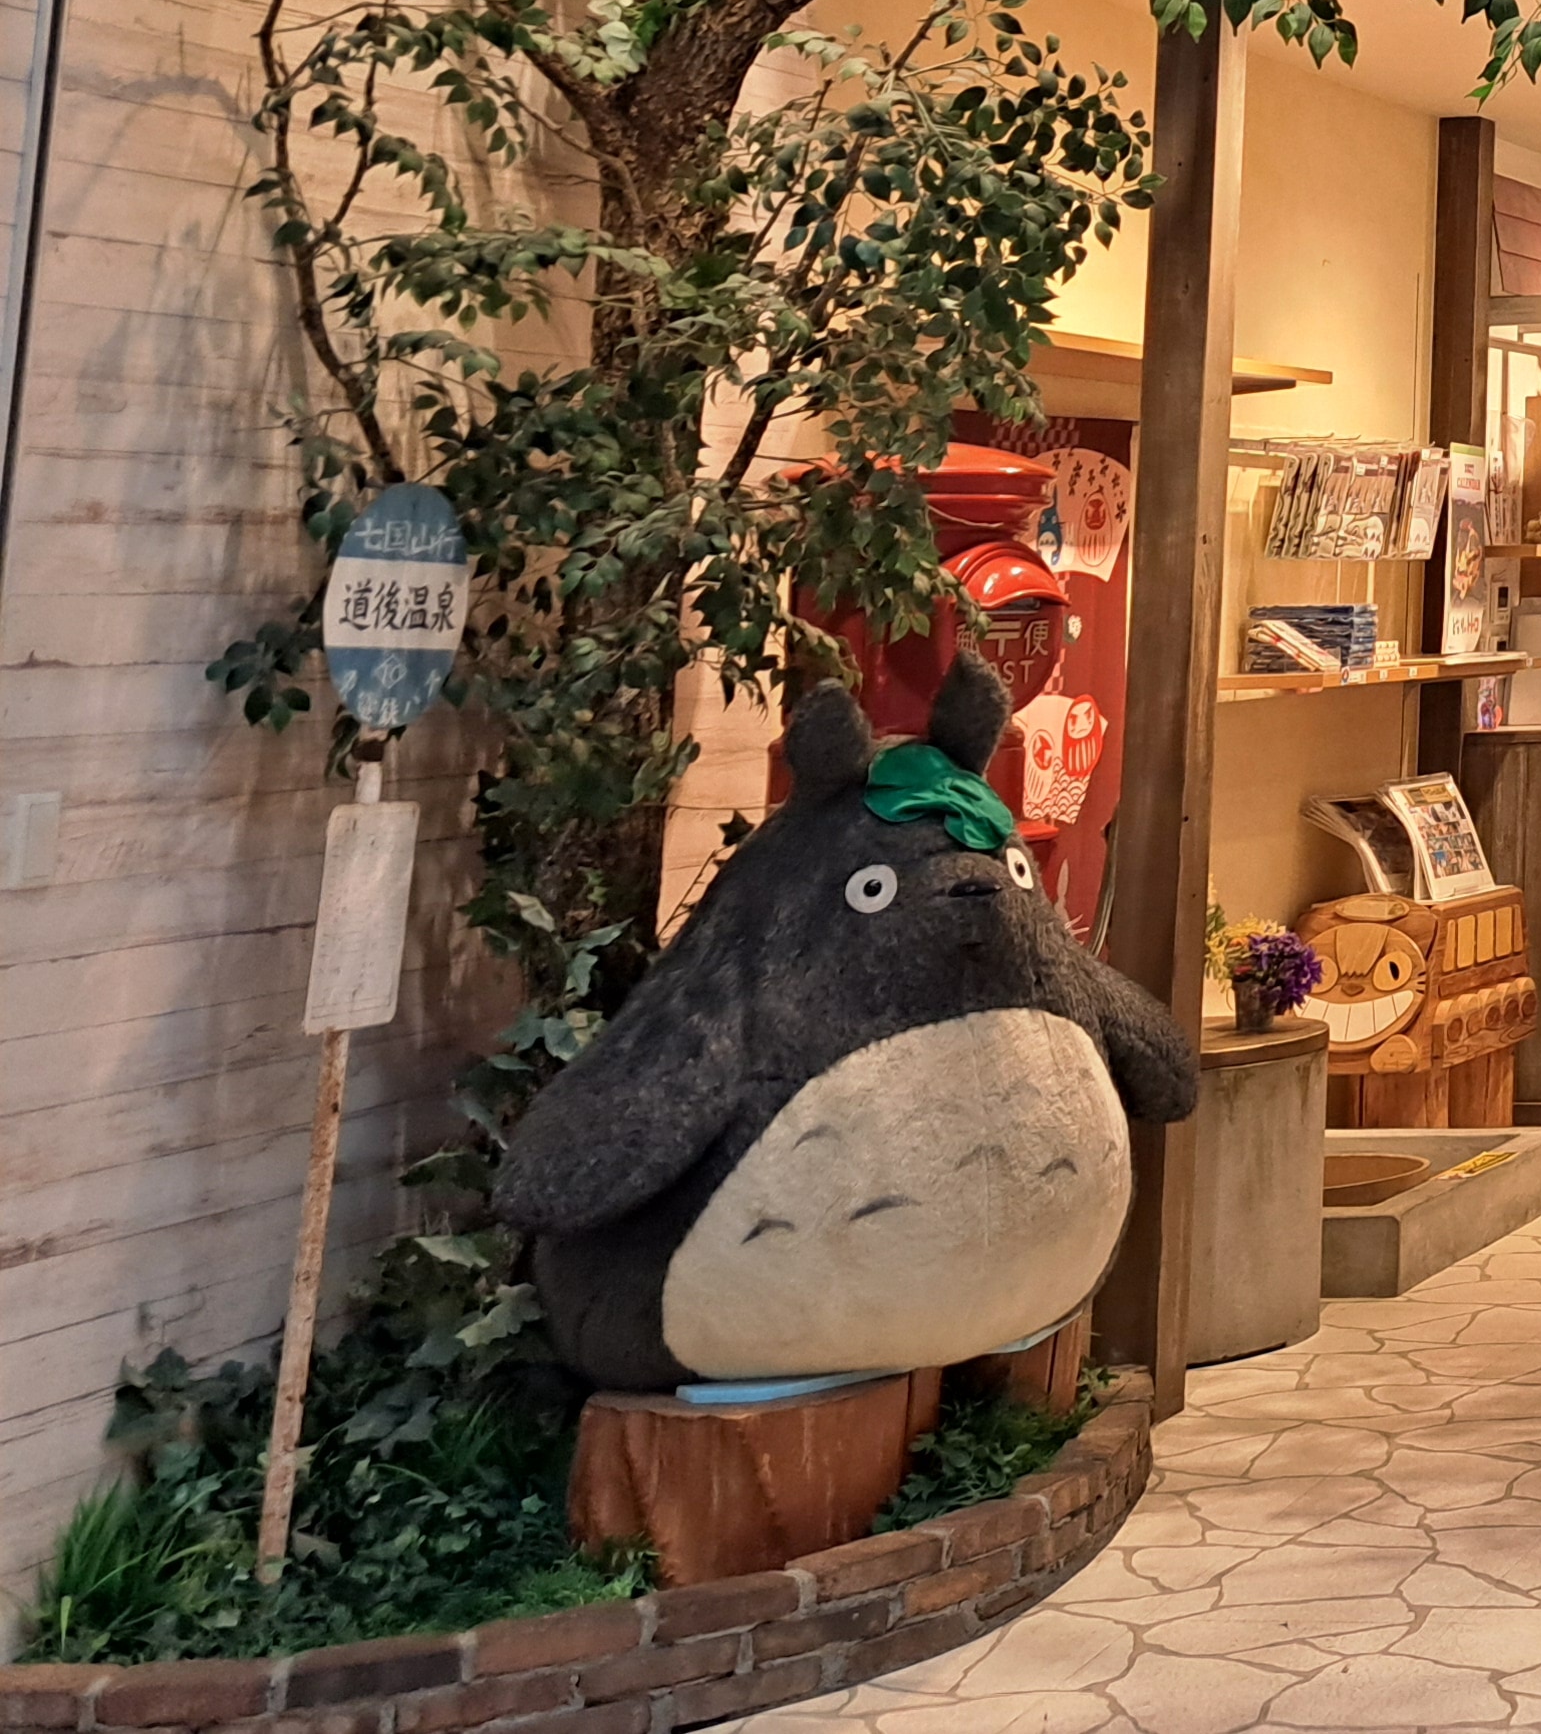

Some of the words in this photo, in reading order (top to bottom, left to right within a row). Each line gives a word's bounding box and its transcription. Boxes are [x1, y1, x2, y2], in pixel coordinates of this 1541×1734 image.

[354, 517, 462, 560] 七国山行
[338, 578, 456, 633] 道後温泉
